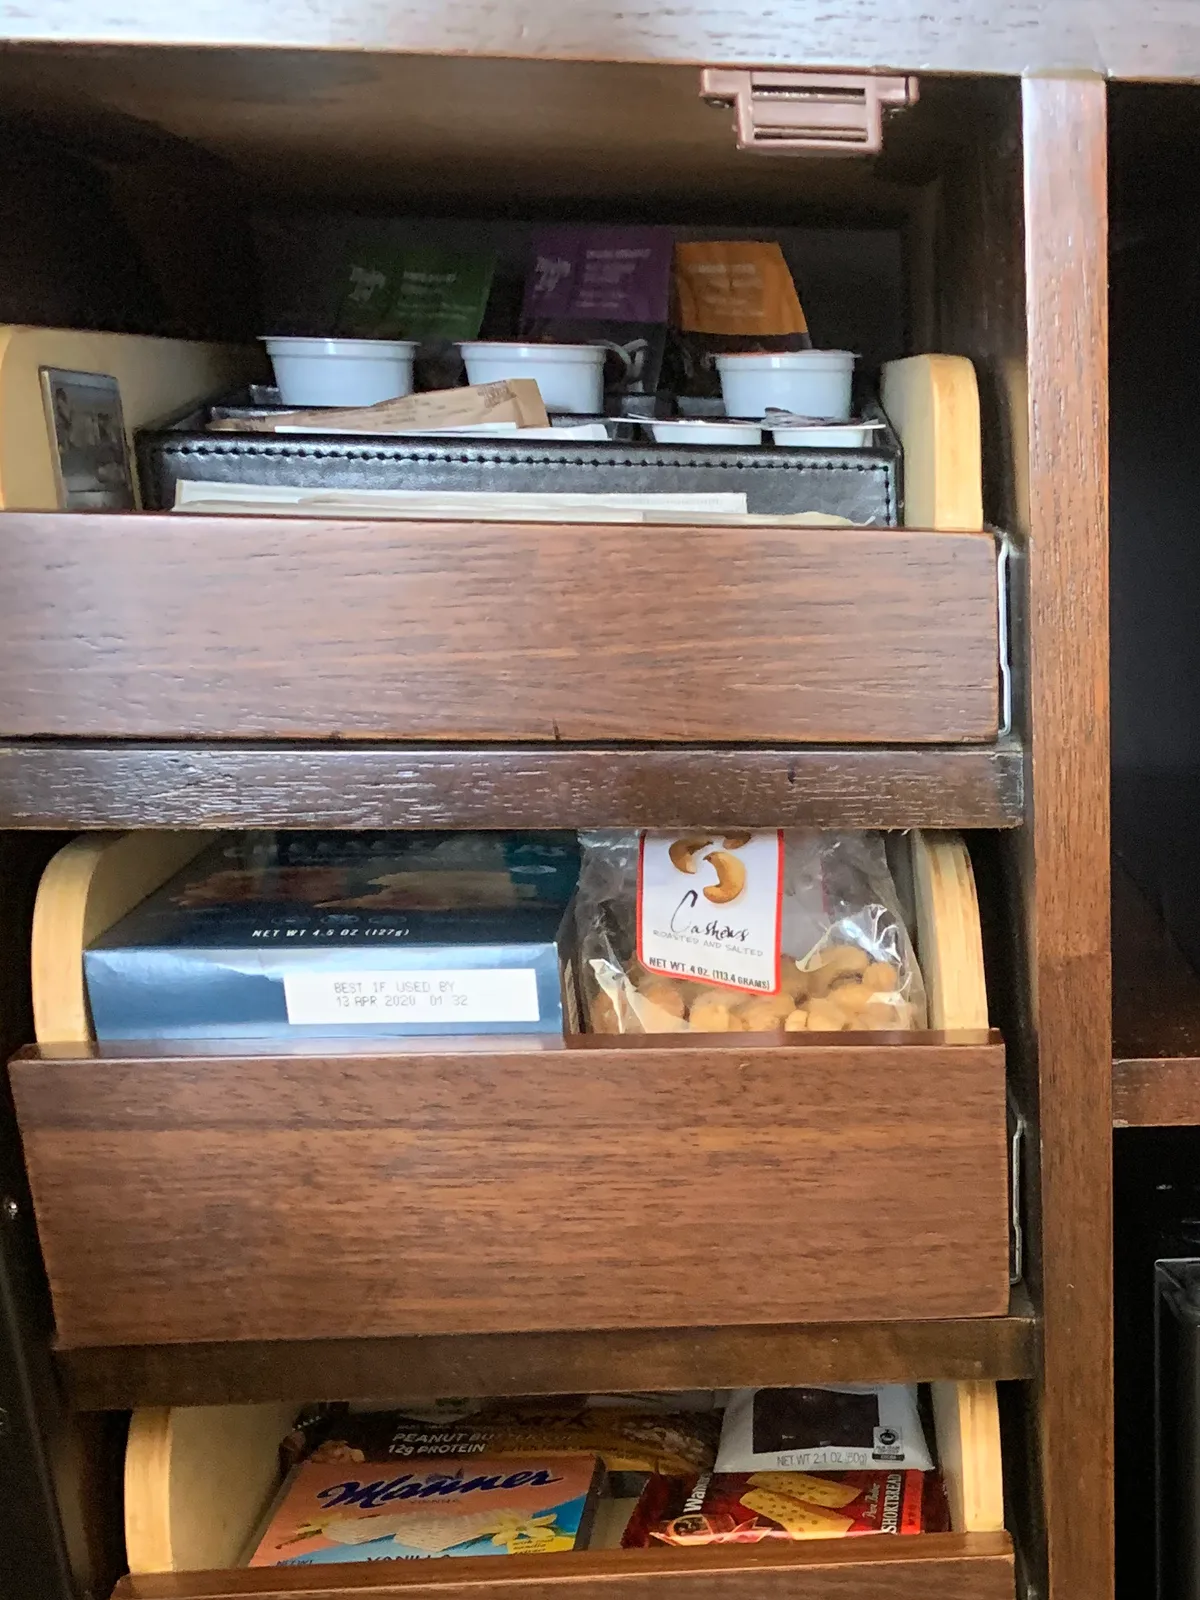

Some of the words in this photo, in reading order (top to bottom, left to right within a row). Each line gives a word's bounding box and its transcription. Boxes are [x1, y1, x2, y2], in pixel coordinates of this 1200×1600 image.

[670, 889, 749, 942] Cashews
[252, 929, 280, 938] NET
[286, 929, 306, 937] WT
[365, 928, 410, 937] (127g)
[652, 929, 699, 945] ROASTED
[703, 940, 722, 949] AND
[725, 944, 764, 957] SALTED
[649, 957, 667, 968] NET
[712, 969, 736, 983] (113.4
[738, 978, 770, 990] GRAMS)
[334, 982, 362, 994] BEST
[396, 981, 431, 993] USED
[439, 981, 455, 993] BY
[354, 995, 378, 1007] APR
[384, 995, 416, 1007] 2020
[392, 1432, 468, 1443] PEANUT
[388, 1443, 414, 1456] 12g
[417, 1443, 486, 1454] PROTEIN
[777, 1455, 794, 1466] NET
[797, 1454, 811, 1465] WT
[316, 1467, 564, 1510] Manner
[881, 1473, 902, 1534] SHORTBREAD
